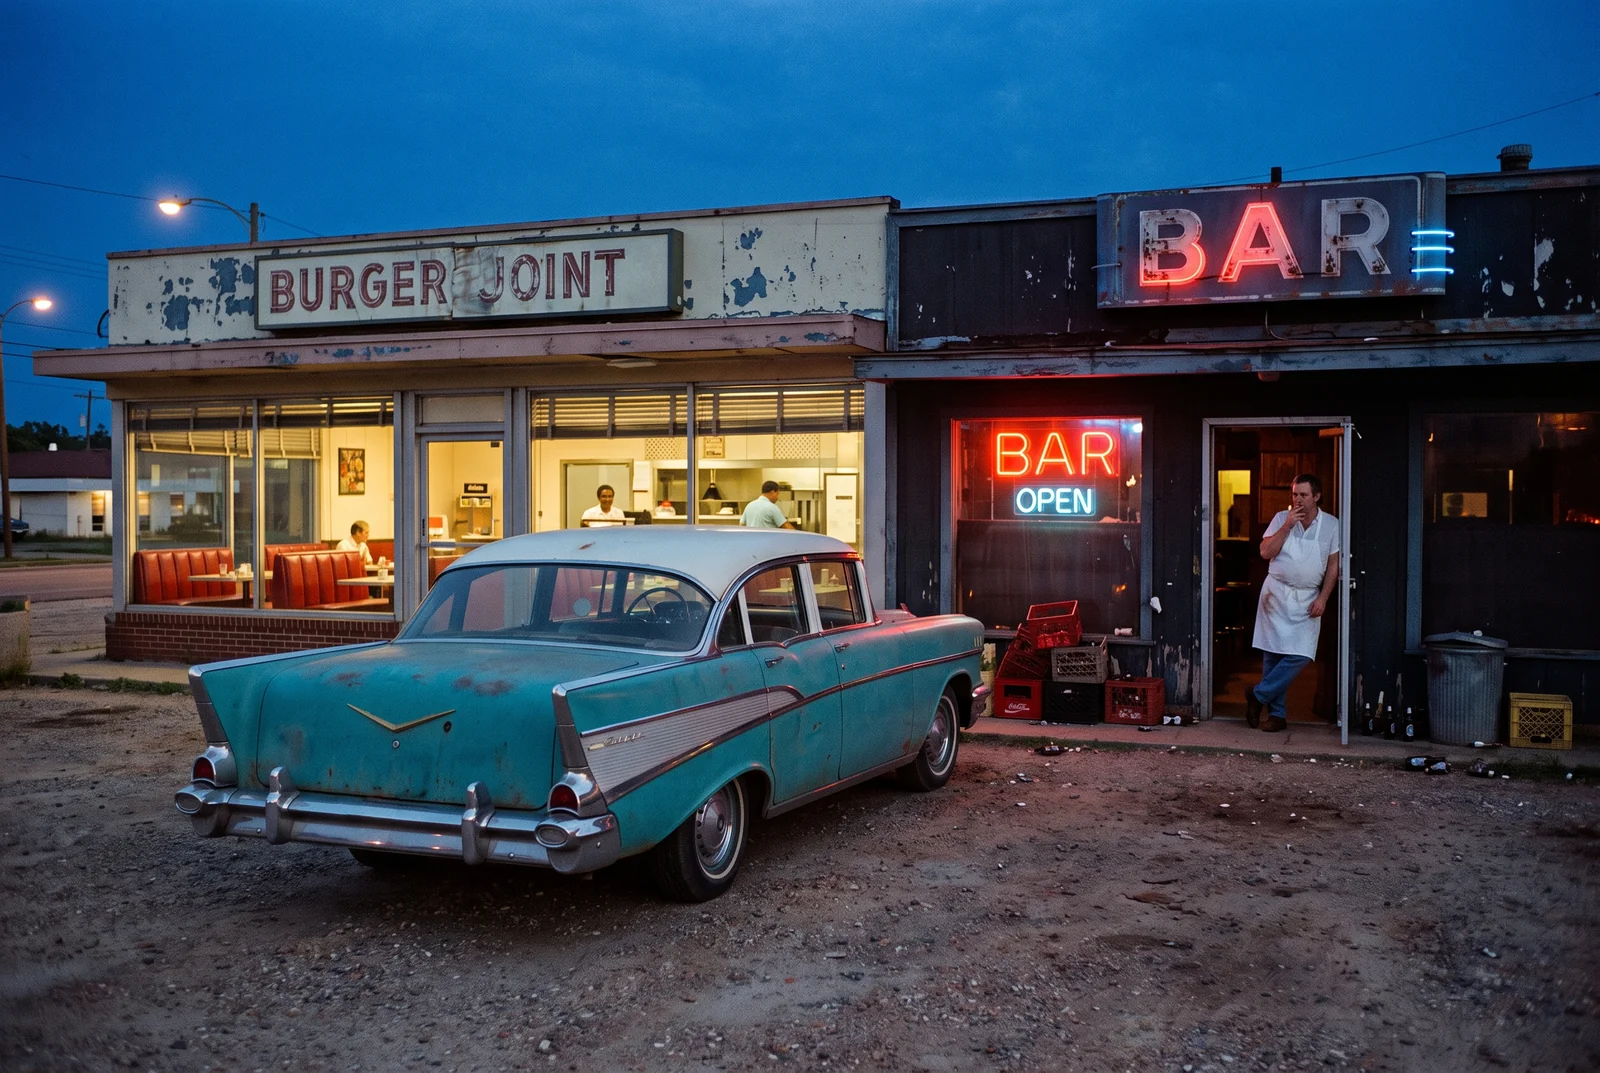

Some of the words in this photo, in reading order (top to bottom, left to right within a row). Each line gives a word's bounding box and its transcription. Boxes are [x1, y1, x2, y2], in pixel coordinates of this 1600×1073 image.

[1139, 196, 1392, 287] BAR
[270, 257, 449, 314] BURGER
[479, 248, 626, 303] JOINT
[996, 431, 1115, 476] BAR
[1016, 487, 1092, 515] OPEN
